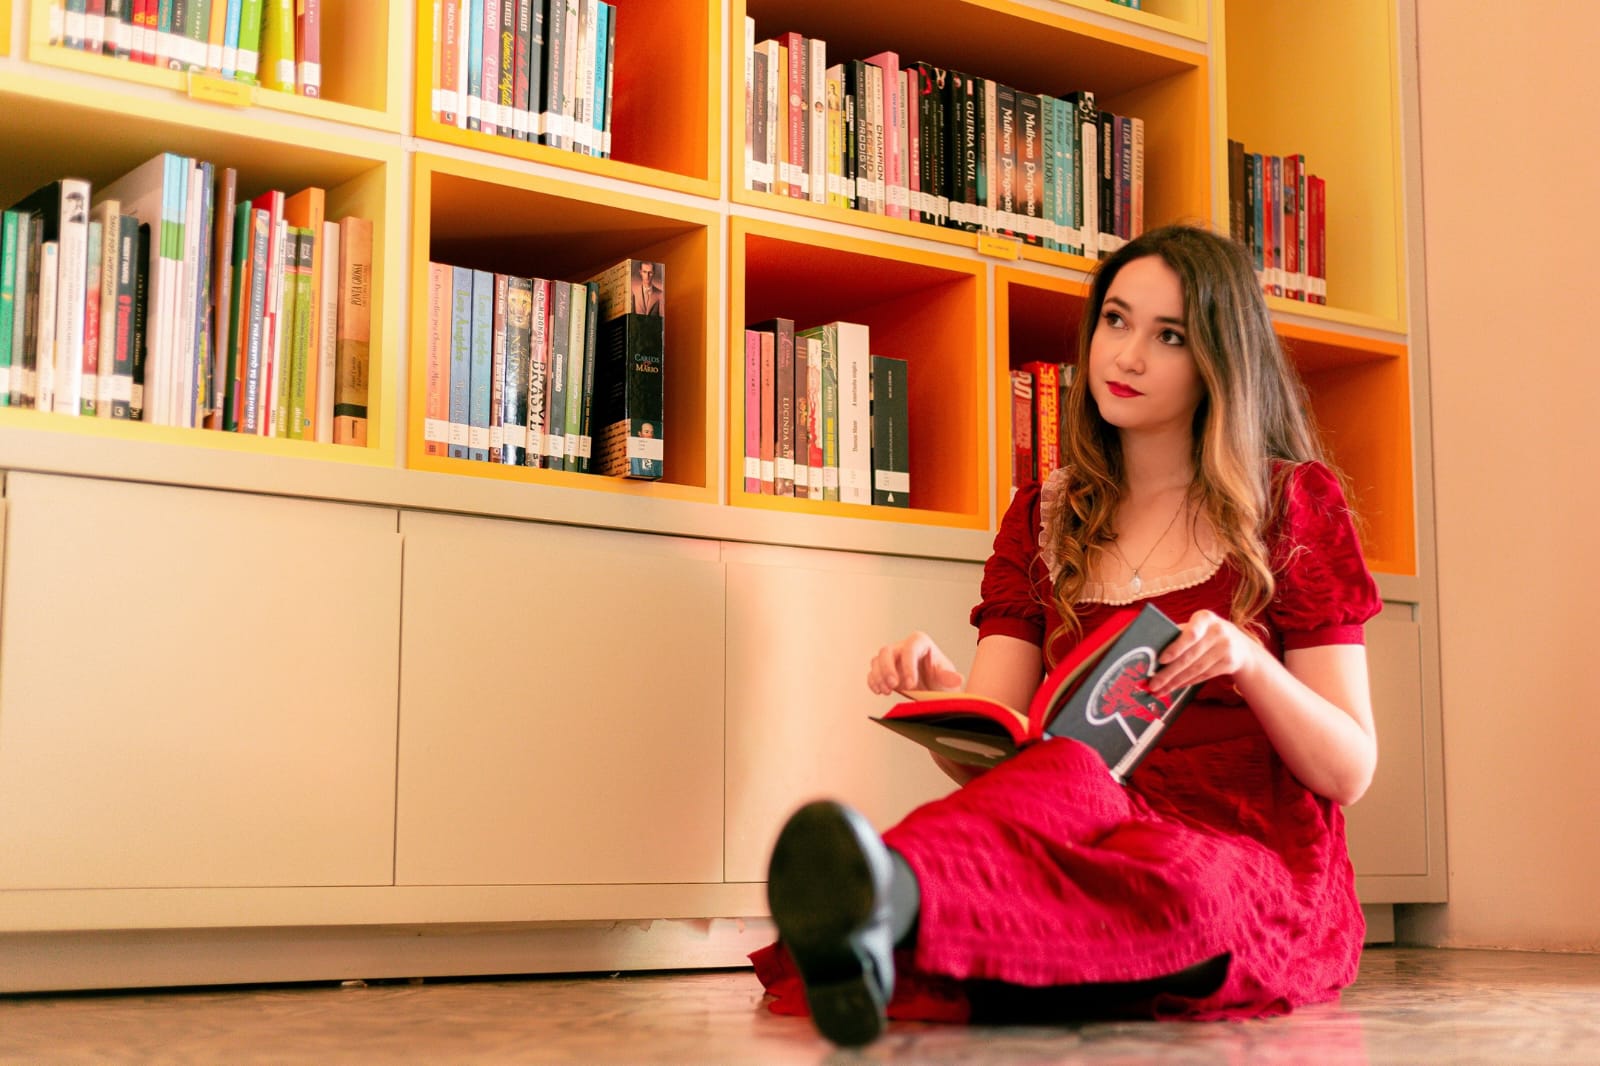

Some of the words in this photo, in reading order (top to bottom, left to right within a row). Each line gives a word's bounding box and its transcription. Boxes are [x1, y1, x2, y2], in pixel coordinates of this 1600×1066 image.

[858, 119, 867, 171] PRODIGY
[967, 101, 975, 147] GUERRA
[1001, 107, 1013, 154] Mulheres
[1024, 112, 1036, 158] Mulheres
[1044, 101, 1054, 185] ENRAIZADOS
[866, 122, 874, 173] LEGEND
[876, 124, 884, 181] CHAMPION
[967, 150, 975, 182] CIVIL
[456, 289, 470, 313] Los
[454, 317, 470, 362] Angeles
[475, 318, 490, 366] Angeles
[782, 397, 790, 441] LUCINDA
